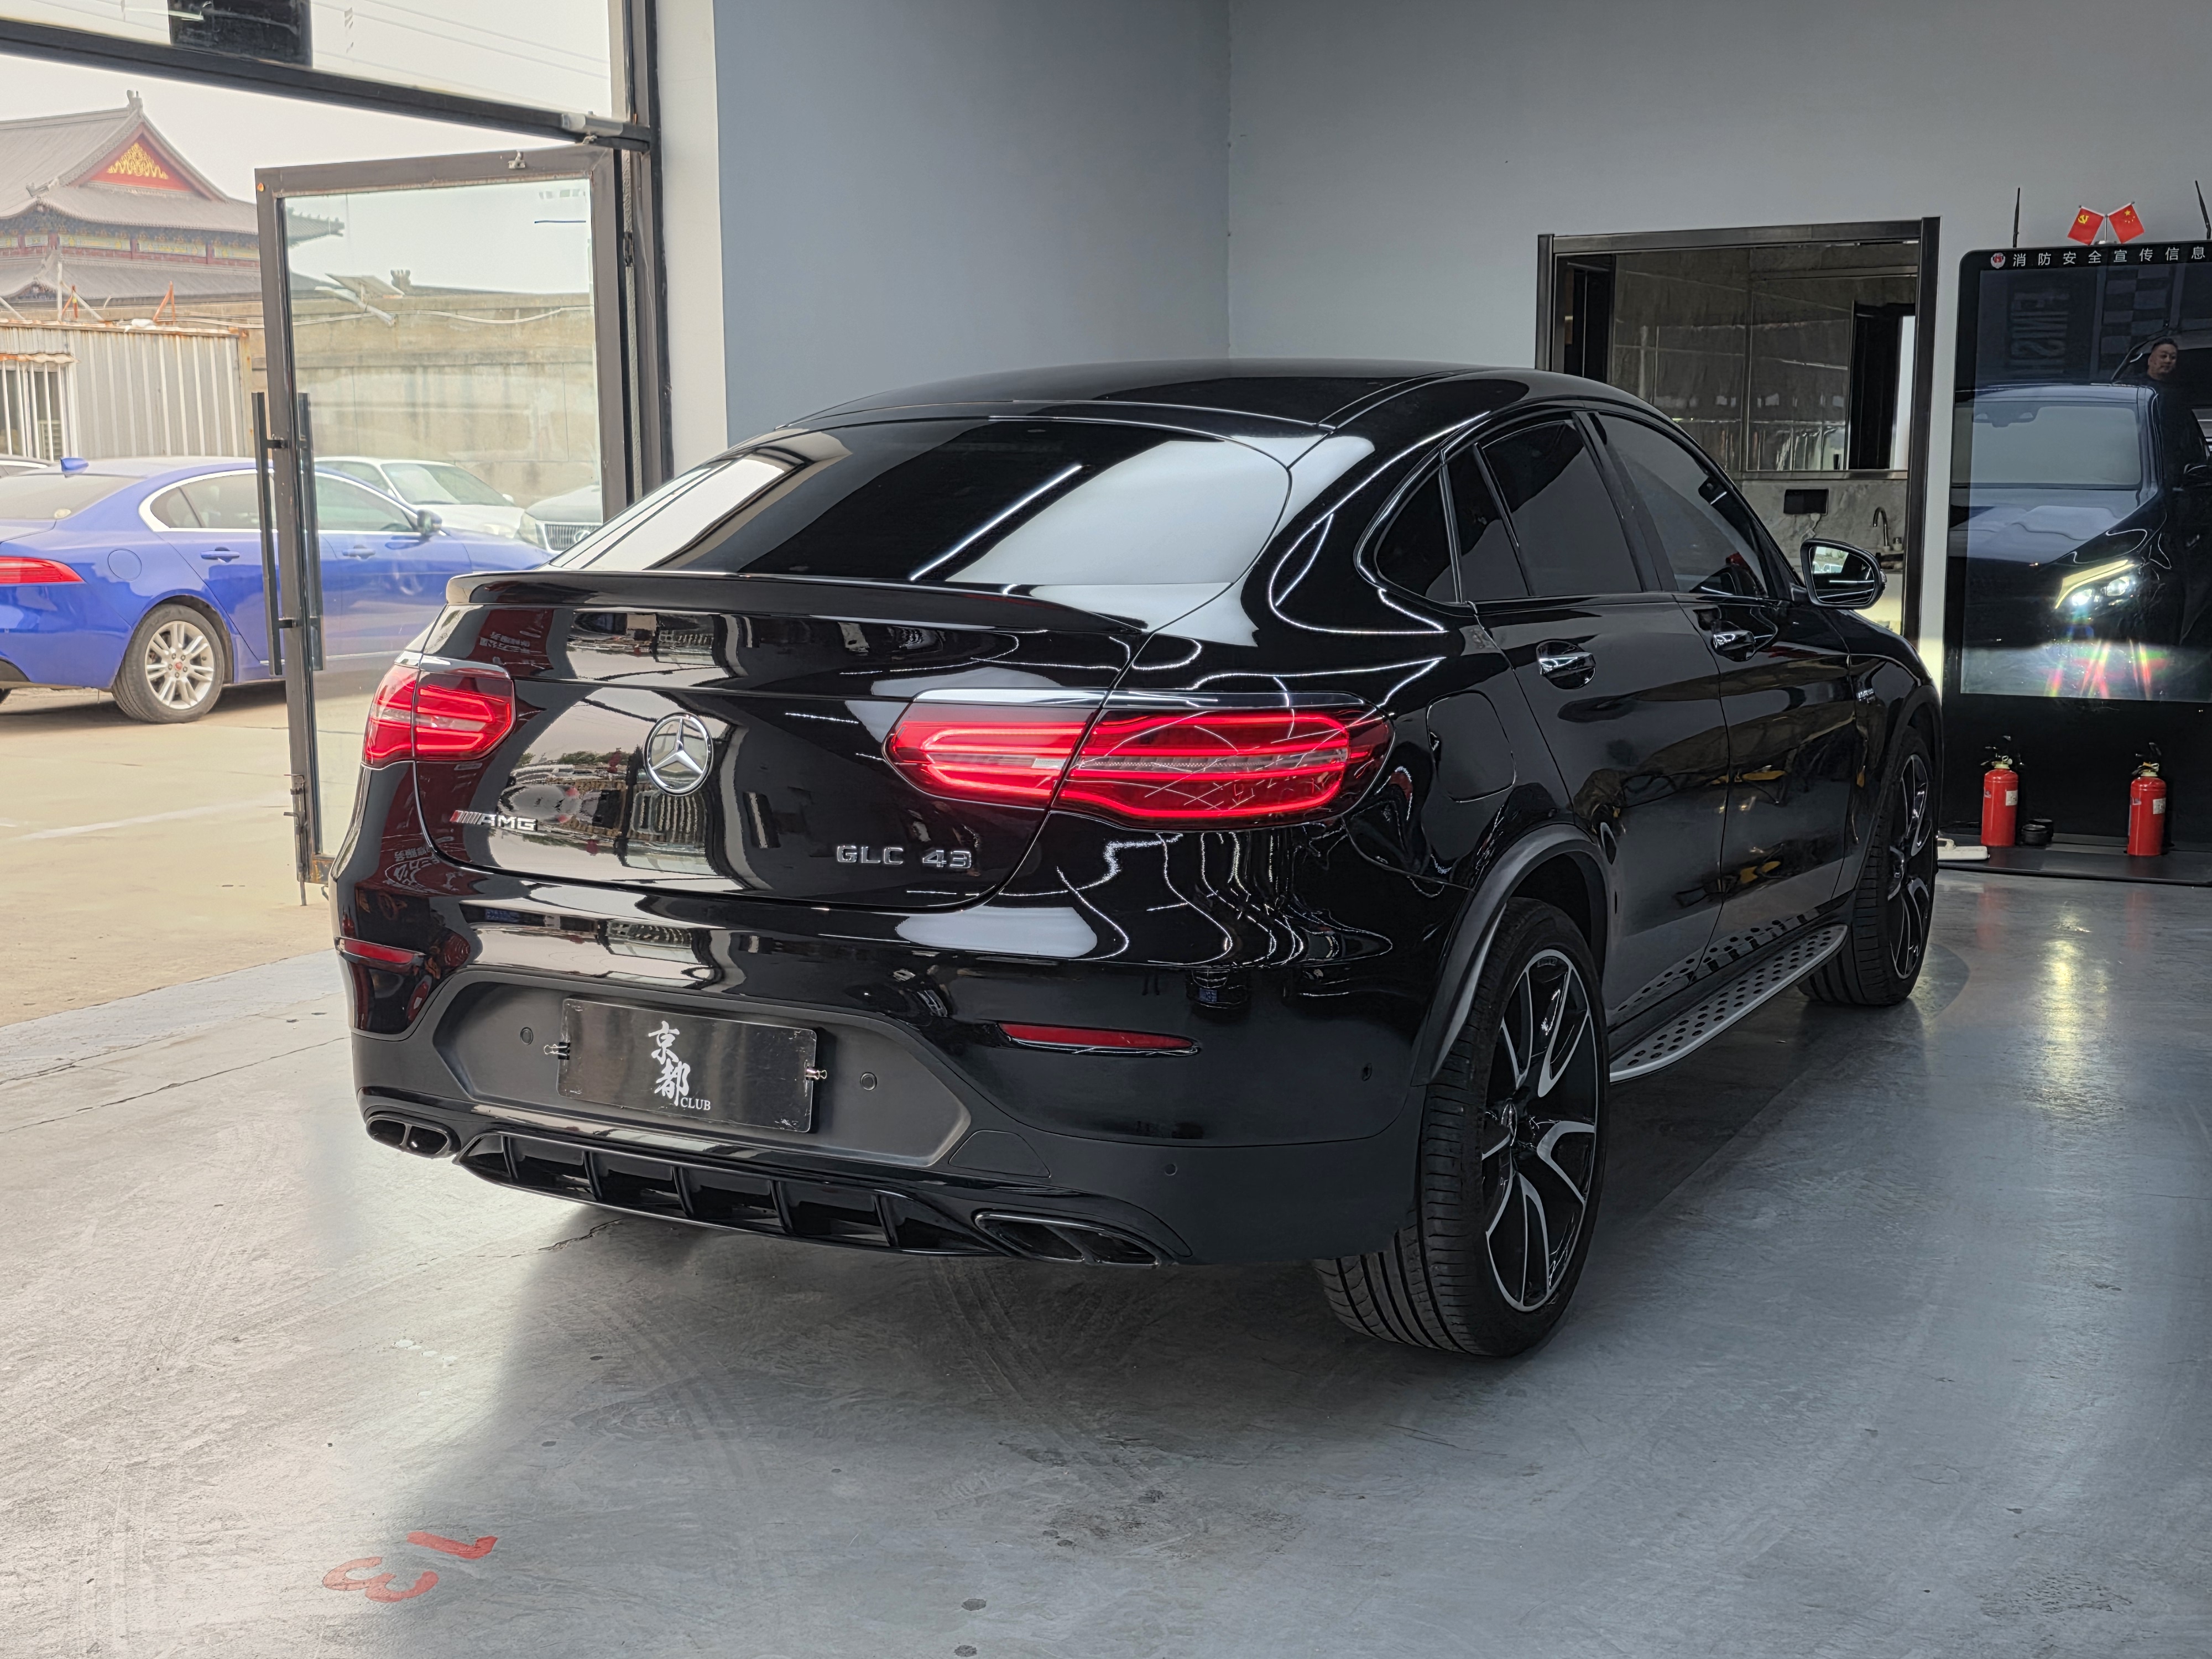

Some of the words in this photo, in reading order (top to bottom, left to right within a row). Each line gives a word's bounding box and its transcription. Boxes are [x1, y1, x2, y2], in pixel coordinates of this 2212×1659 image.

[2012, 247, 2205, 267] 消防安全宣传信息
[476, 812, 537, 831] AMG
[837, 845, 904, 865] GLC
[922, 850, 972, 868] 43
[648, 1020, 691, 1106] 京都
[680, 1097, 711, 1110] CLUB
